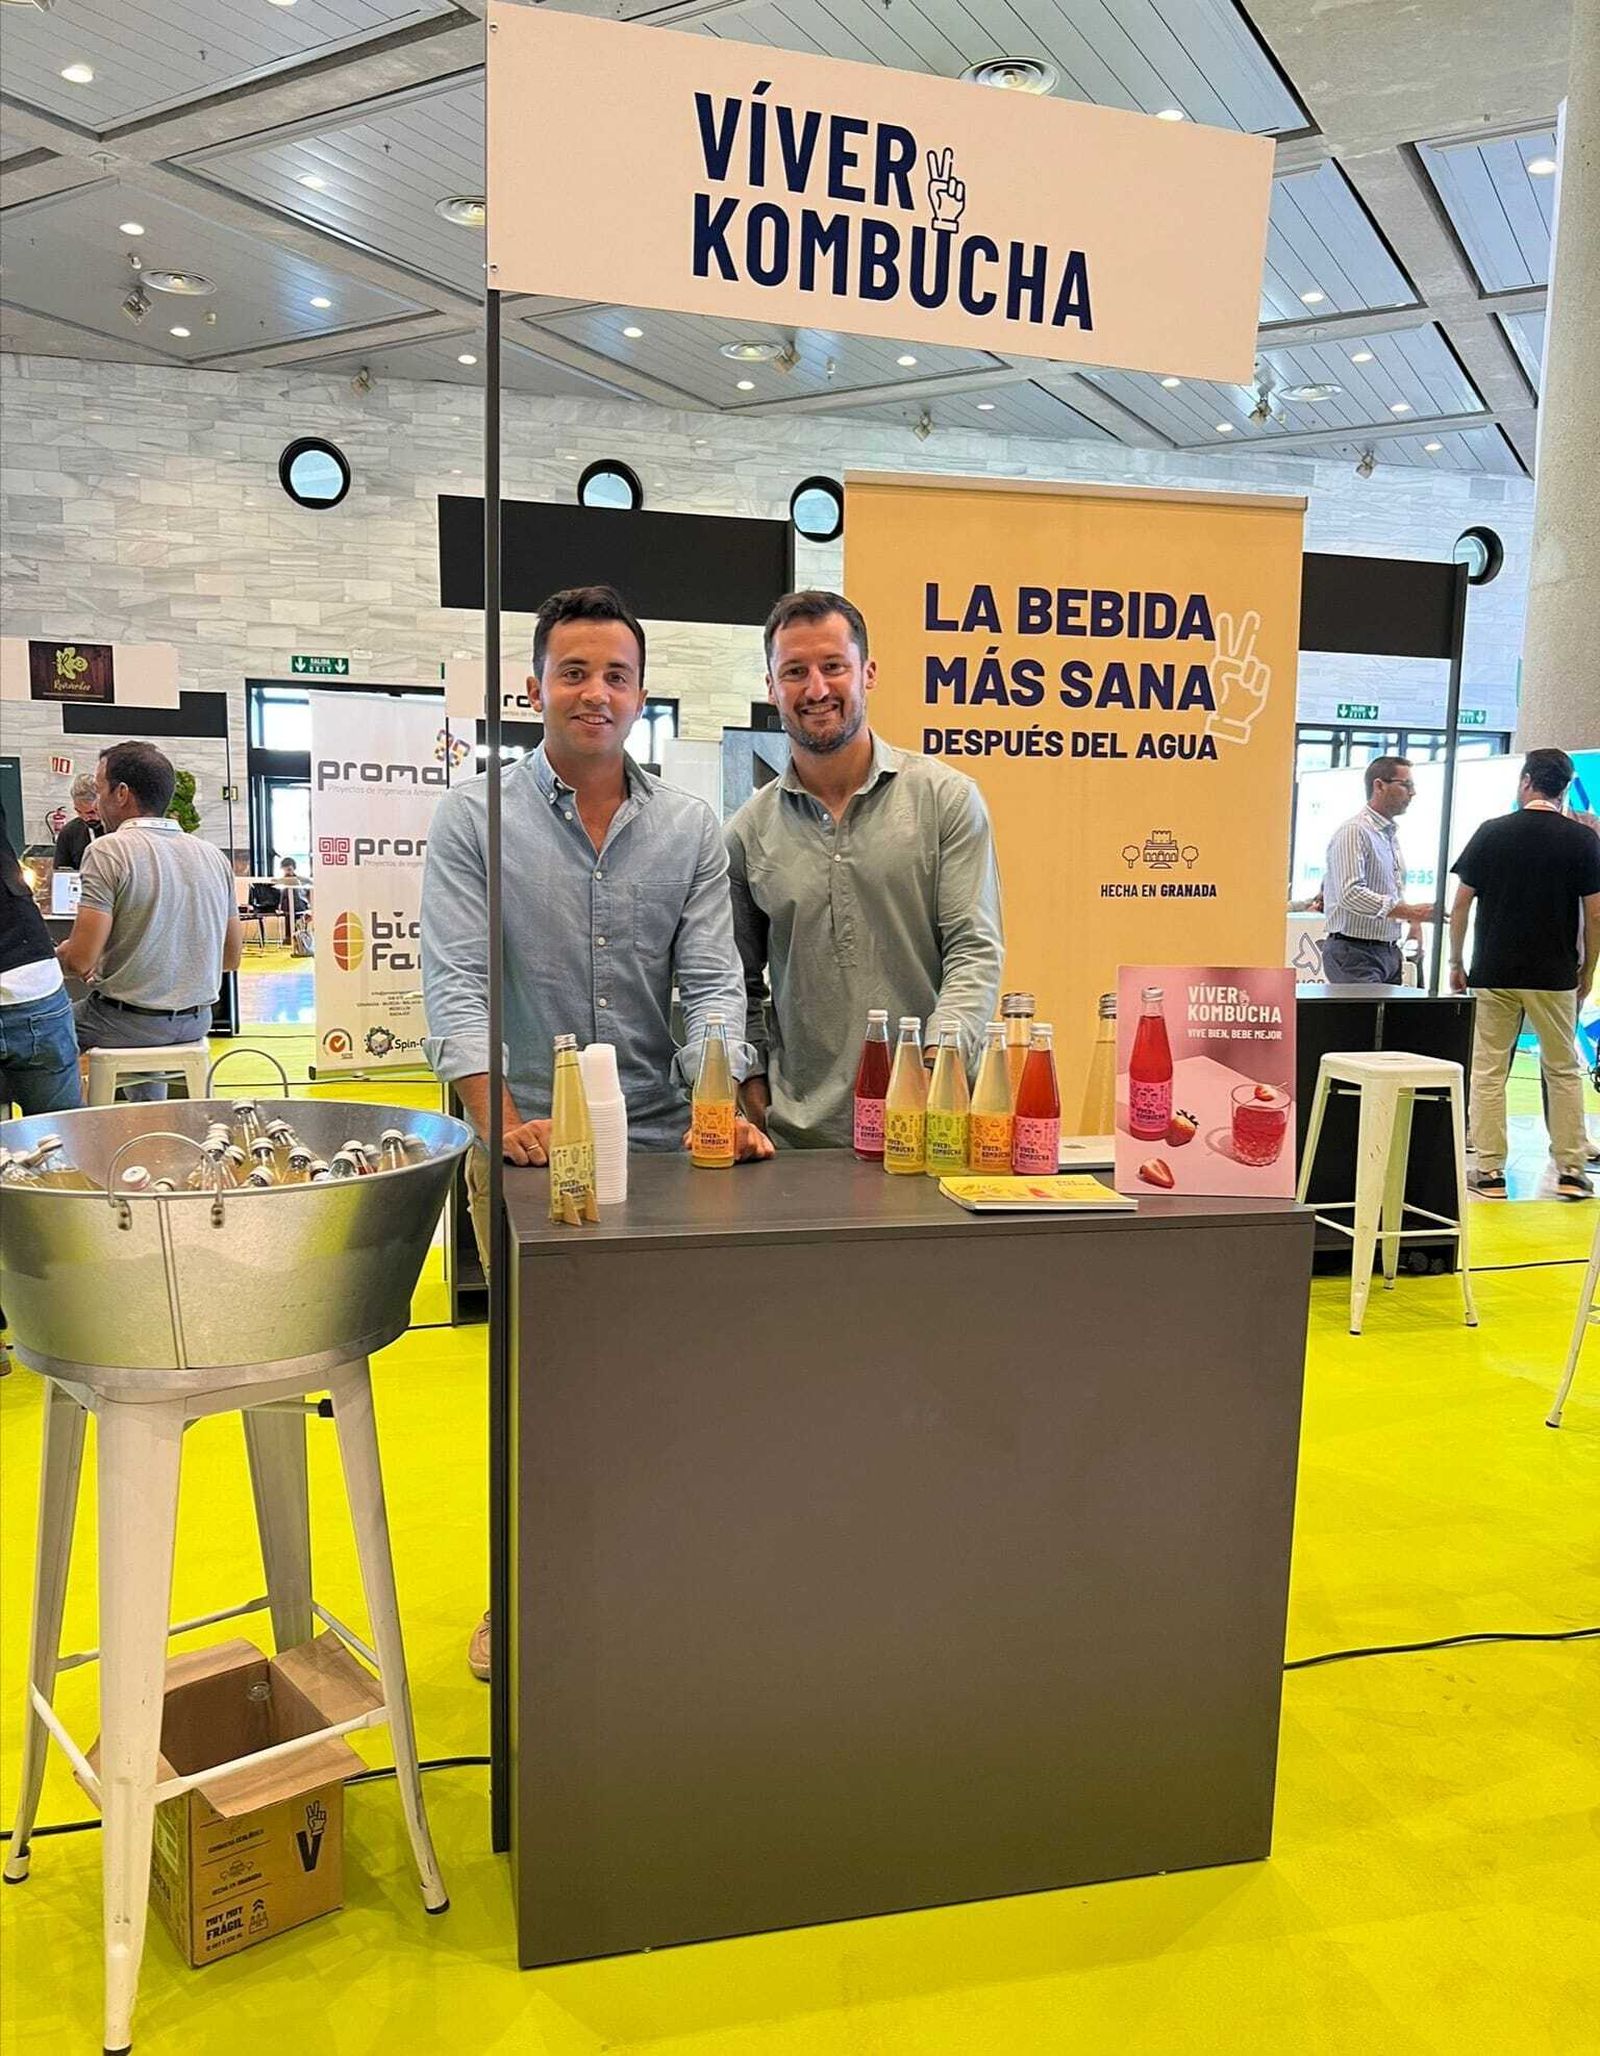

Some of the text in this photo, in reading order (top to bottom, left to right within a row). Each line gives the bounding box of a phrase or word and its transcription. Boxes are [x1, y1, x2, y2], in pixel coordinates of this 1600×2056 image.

[694, 80, 918, 210] VÍVER
[692, 193, 1094, 331] KOMBUCHA
[924, 582, 1217, 641] LA BEBIDA
[924, 646, 1217, 711] MÁS SANA
[923, 725, 1218, 760] DESPUÉS DEL AGUA
[1100, 884, 1217, 898] HECHA EN GRANADA
[371, 942, 422, 971] Fa
[1188, 983, 1238, 1004] VÍVER
[1188, 1004, 1282, 1023] KOMBUCHA
[1188, 1029, 1206, 1039] VIVE
[1231, 1029, 1253, 1039] BEBE
[1254, 1030, 1282, 1040] MEJOR
[296, 1829, 321, 1873] V
[206, 1905, 244, 1928] MUY MUY
[206, 1917, 244, 1941] FRÁGIL
